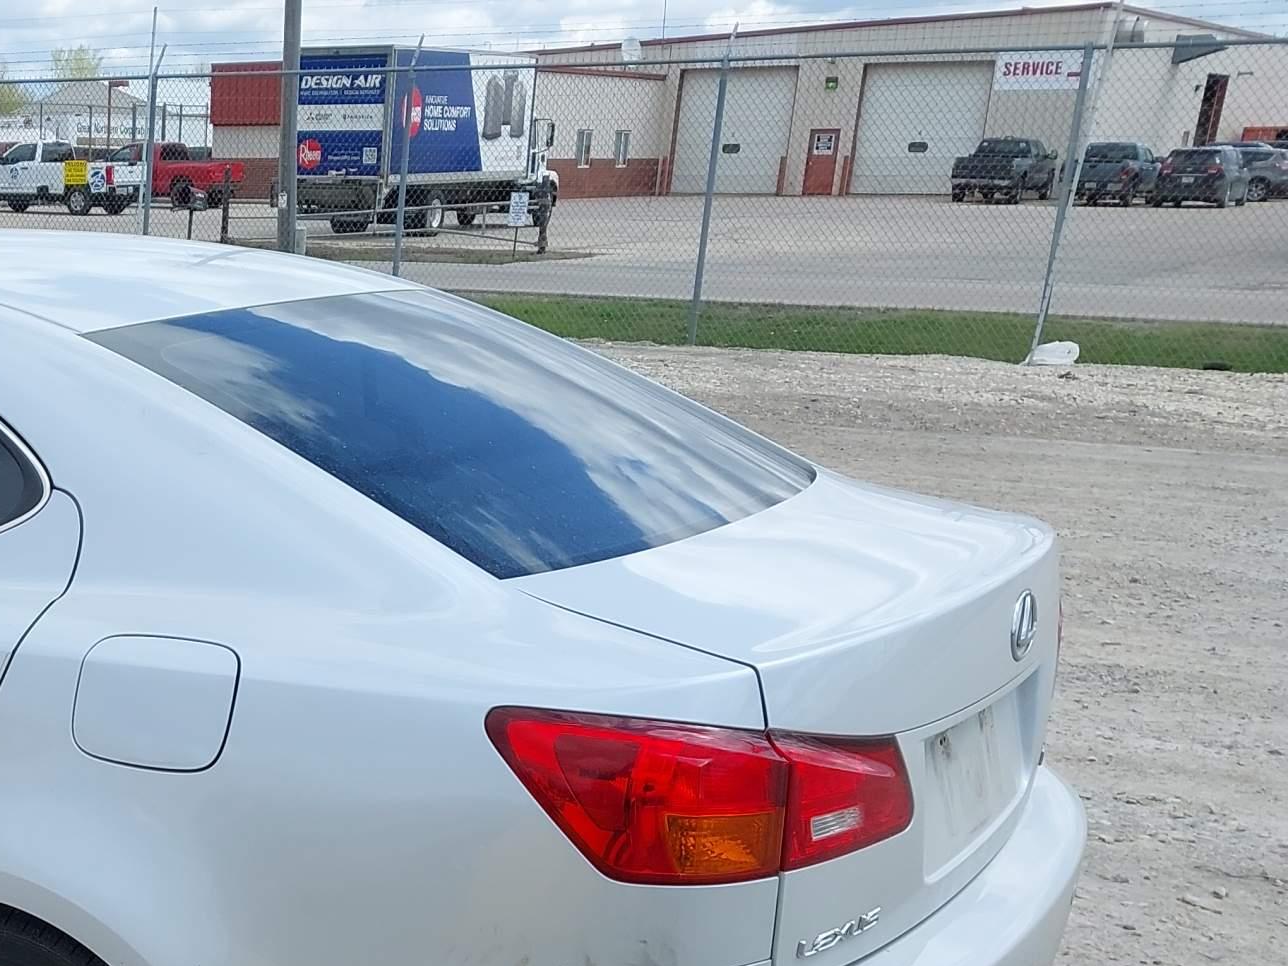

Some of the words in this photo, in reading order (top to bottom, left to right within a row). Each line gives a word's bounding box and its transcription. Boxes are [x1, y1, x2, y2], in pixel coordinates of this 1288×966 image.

[1003, 60, 1063, 77] SERVICE
[300, 74, 353, 89] DESIGN
[353, 74, 382, 88] AIR
[424, 105, 443, 118] HOME
[443, 106, 472, 119] COMFORT
[424, 119, 457, 131] SOLUTIONS
[300, 139, 321, 164] Rheem
[796, 906, 882, 959] LEXUS
